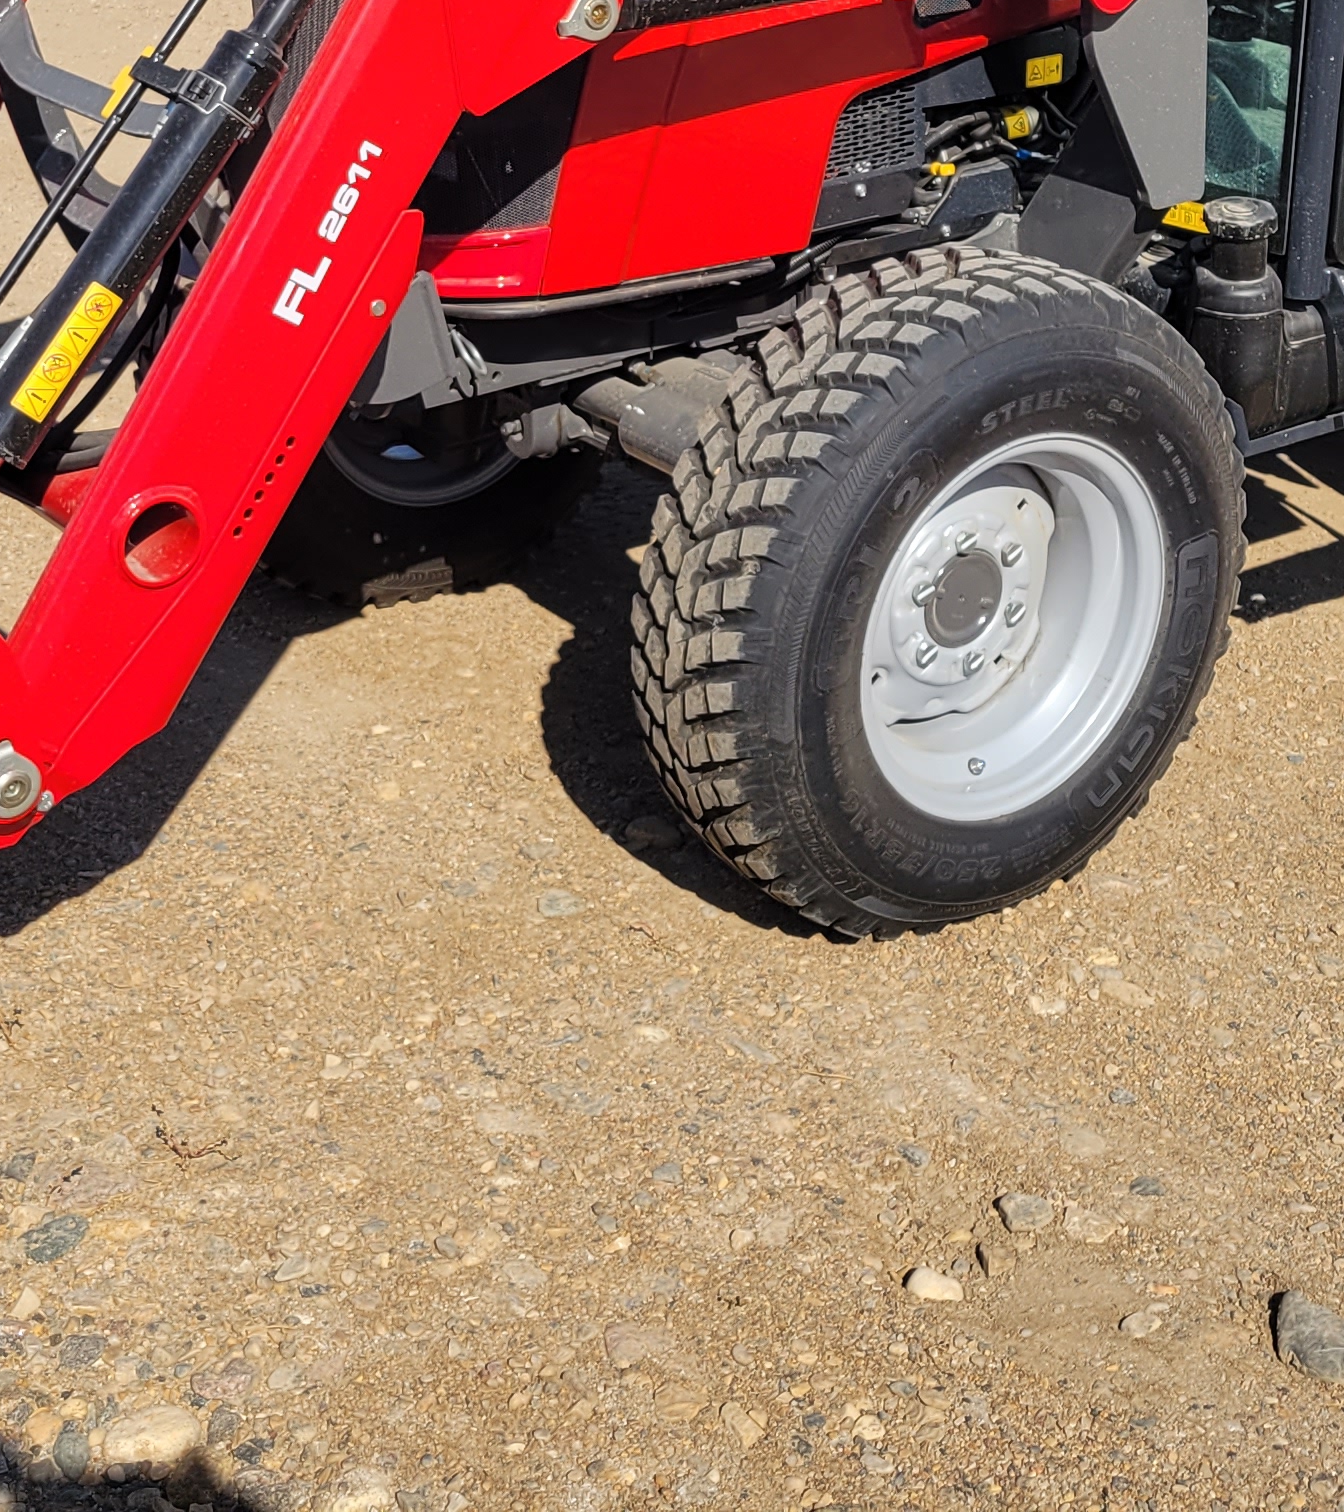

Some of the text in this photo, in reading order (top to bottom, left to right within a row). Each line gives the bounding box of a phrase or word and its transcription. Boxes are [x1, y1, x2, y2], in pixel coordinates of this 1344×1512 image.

[272, 140, 383, 327] FL 2611
[978, 389, 1070, 434] STEEL
